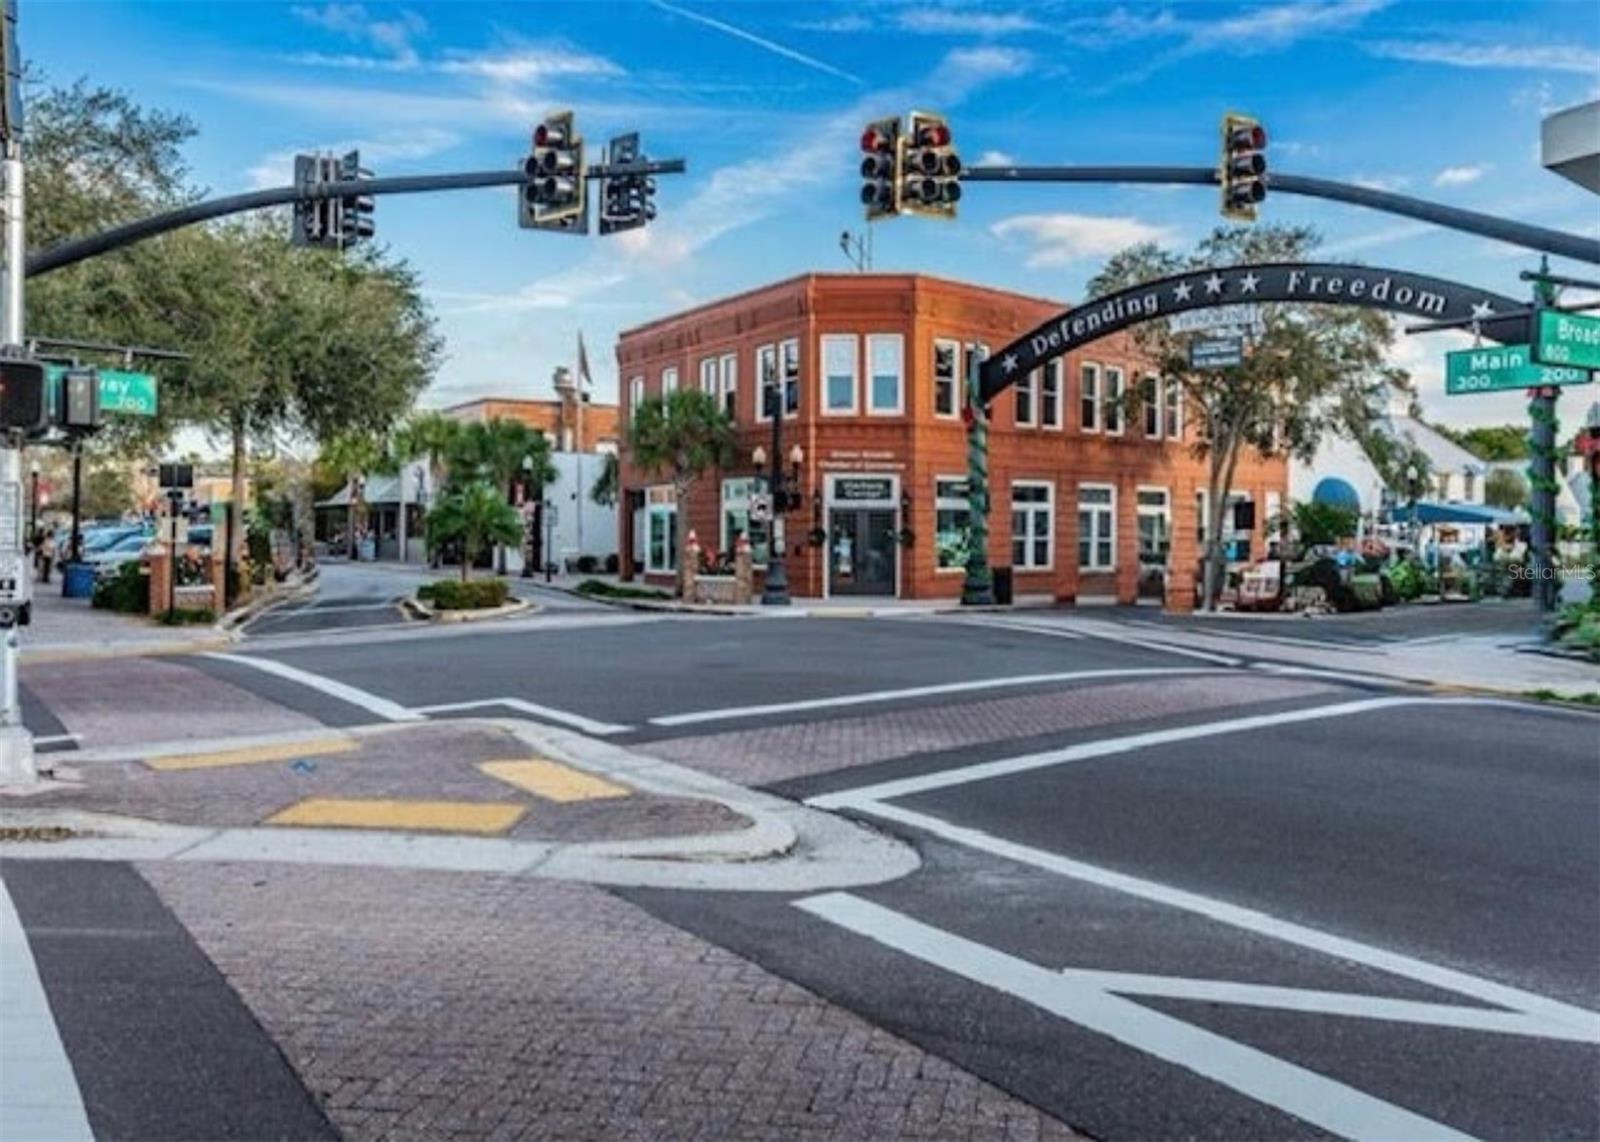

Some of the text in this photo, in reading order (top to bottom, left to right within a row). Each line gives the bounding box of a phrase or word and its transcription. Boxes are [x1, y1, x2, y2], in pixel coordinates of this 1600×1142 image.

[1030, 293, 1159, 356] Defending
[1287, 269, 1446, 314] Freedom
[1471, 353, 1523, 371] Main
